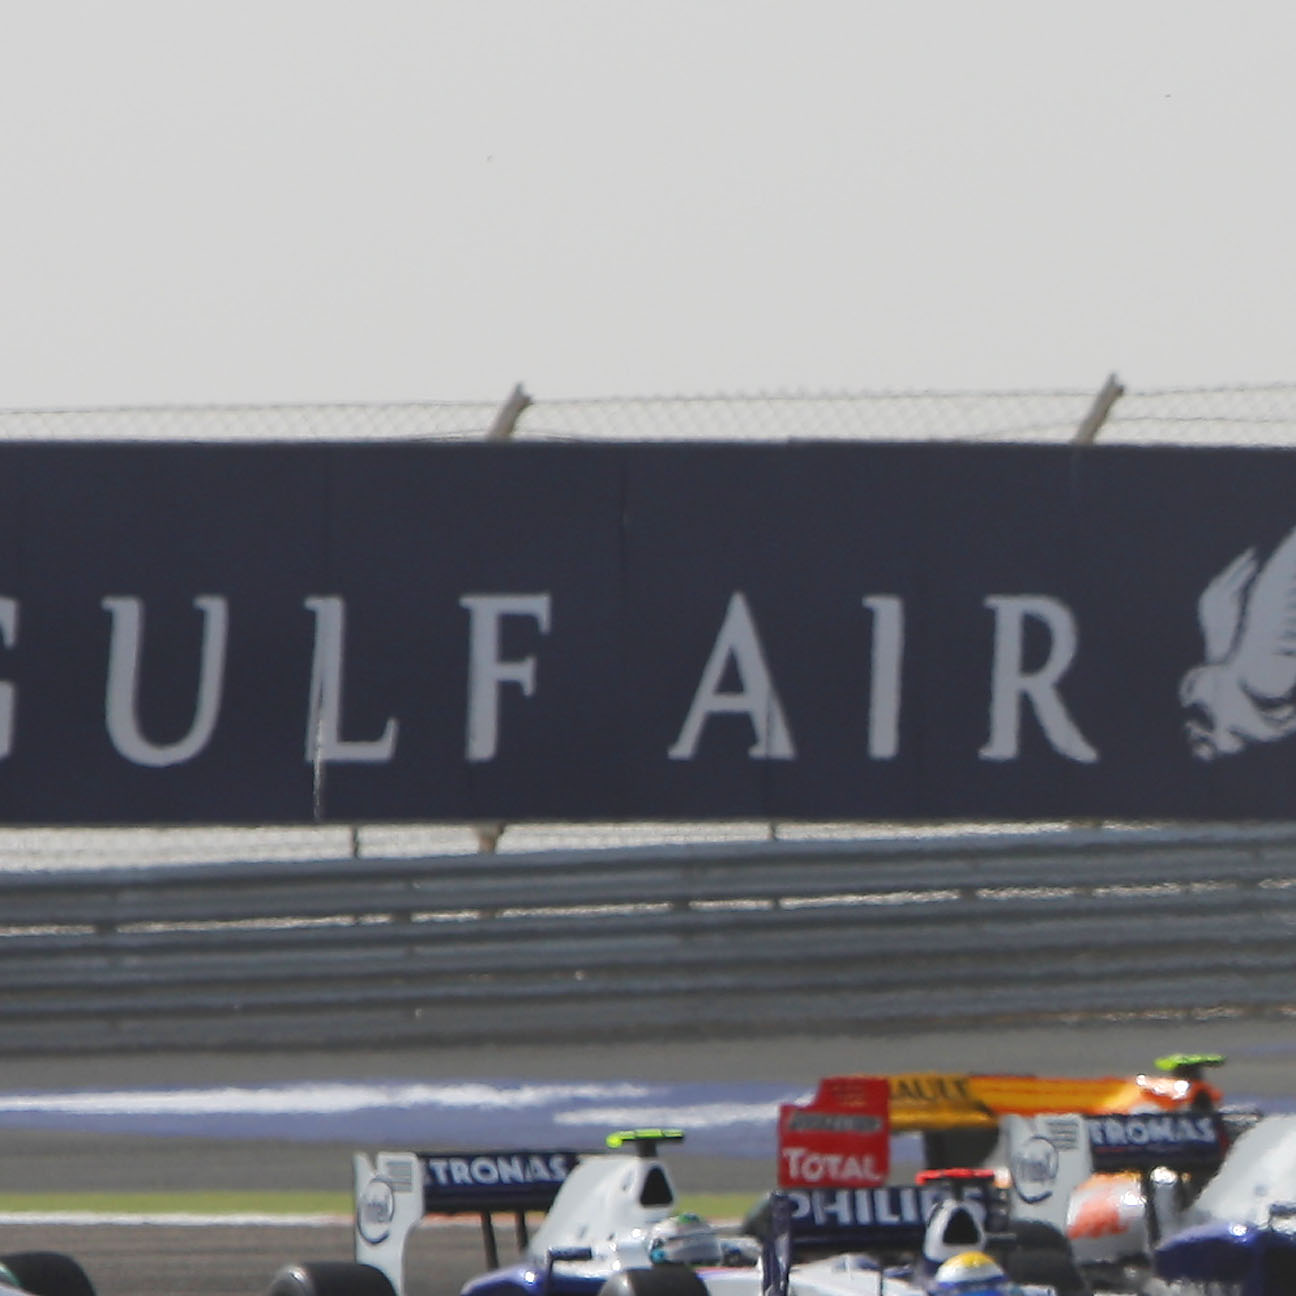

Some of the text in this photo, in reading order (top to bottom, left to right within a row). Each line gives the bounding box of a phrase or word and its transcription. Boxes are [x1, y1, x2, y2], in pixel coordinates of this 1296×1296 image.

[0, 590, 1099, 768] ULF AIR
[1088, 1116, 1216, 1146] TRONAS
[783, 1147, 883, 1182] TOTAL
